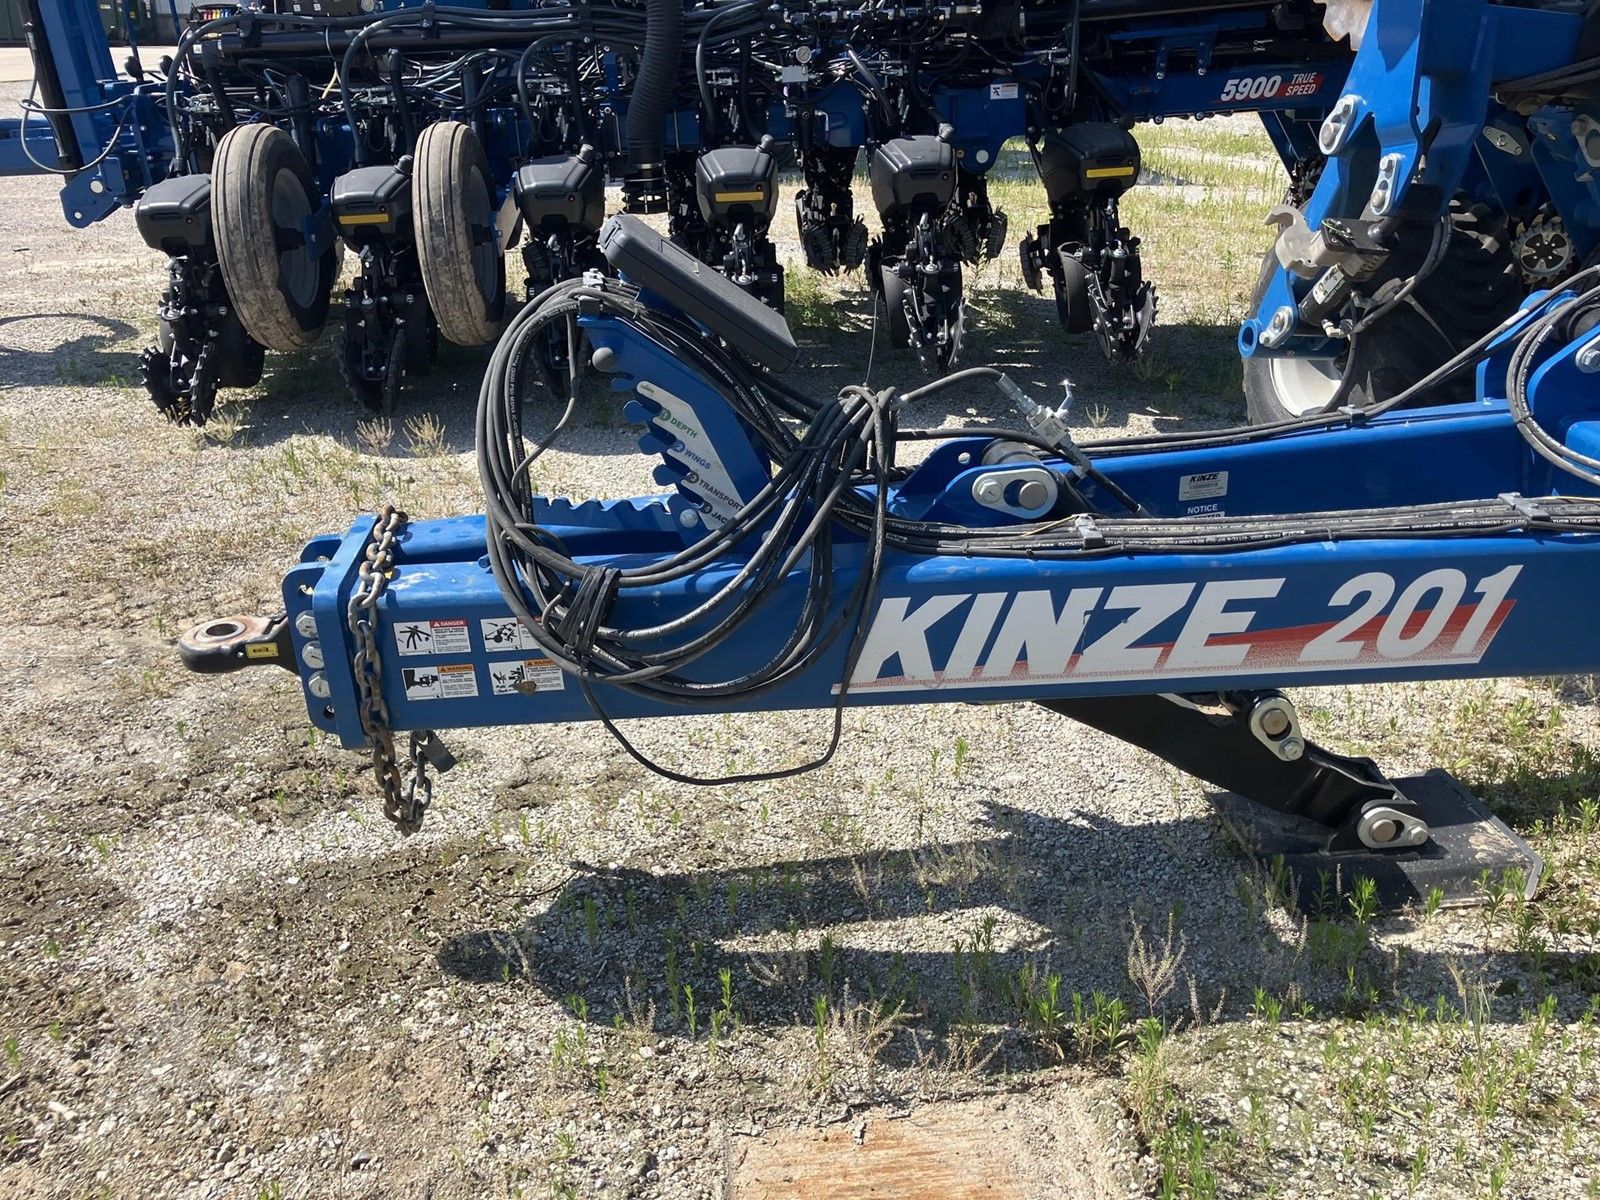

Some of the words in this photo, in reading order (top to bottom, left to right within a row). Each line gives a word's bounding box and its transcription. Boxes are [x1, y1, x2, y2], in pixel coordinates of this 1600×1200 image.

[1291, 72, 1317, 84] TRUE
[1220, 75, 1282, 101] 5900
[1285, 84, 1316, 96] SPEED
[671, 417, 698, 438] DEPTH
[685, 449, 711, 469] WINGS
[1190, 473, 1220, 483] KINZE
[699, 479, 745, 511] TRANSPORT
[1188, 504, 1218, 514] NOTICE
[711, 511, 728, 524] JAC
[840, 577, 1286, 686] KINZE
[1301, 565, 1523, 664] 201
